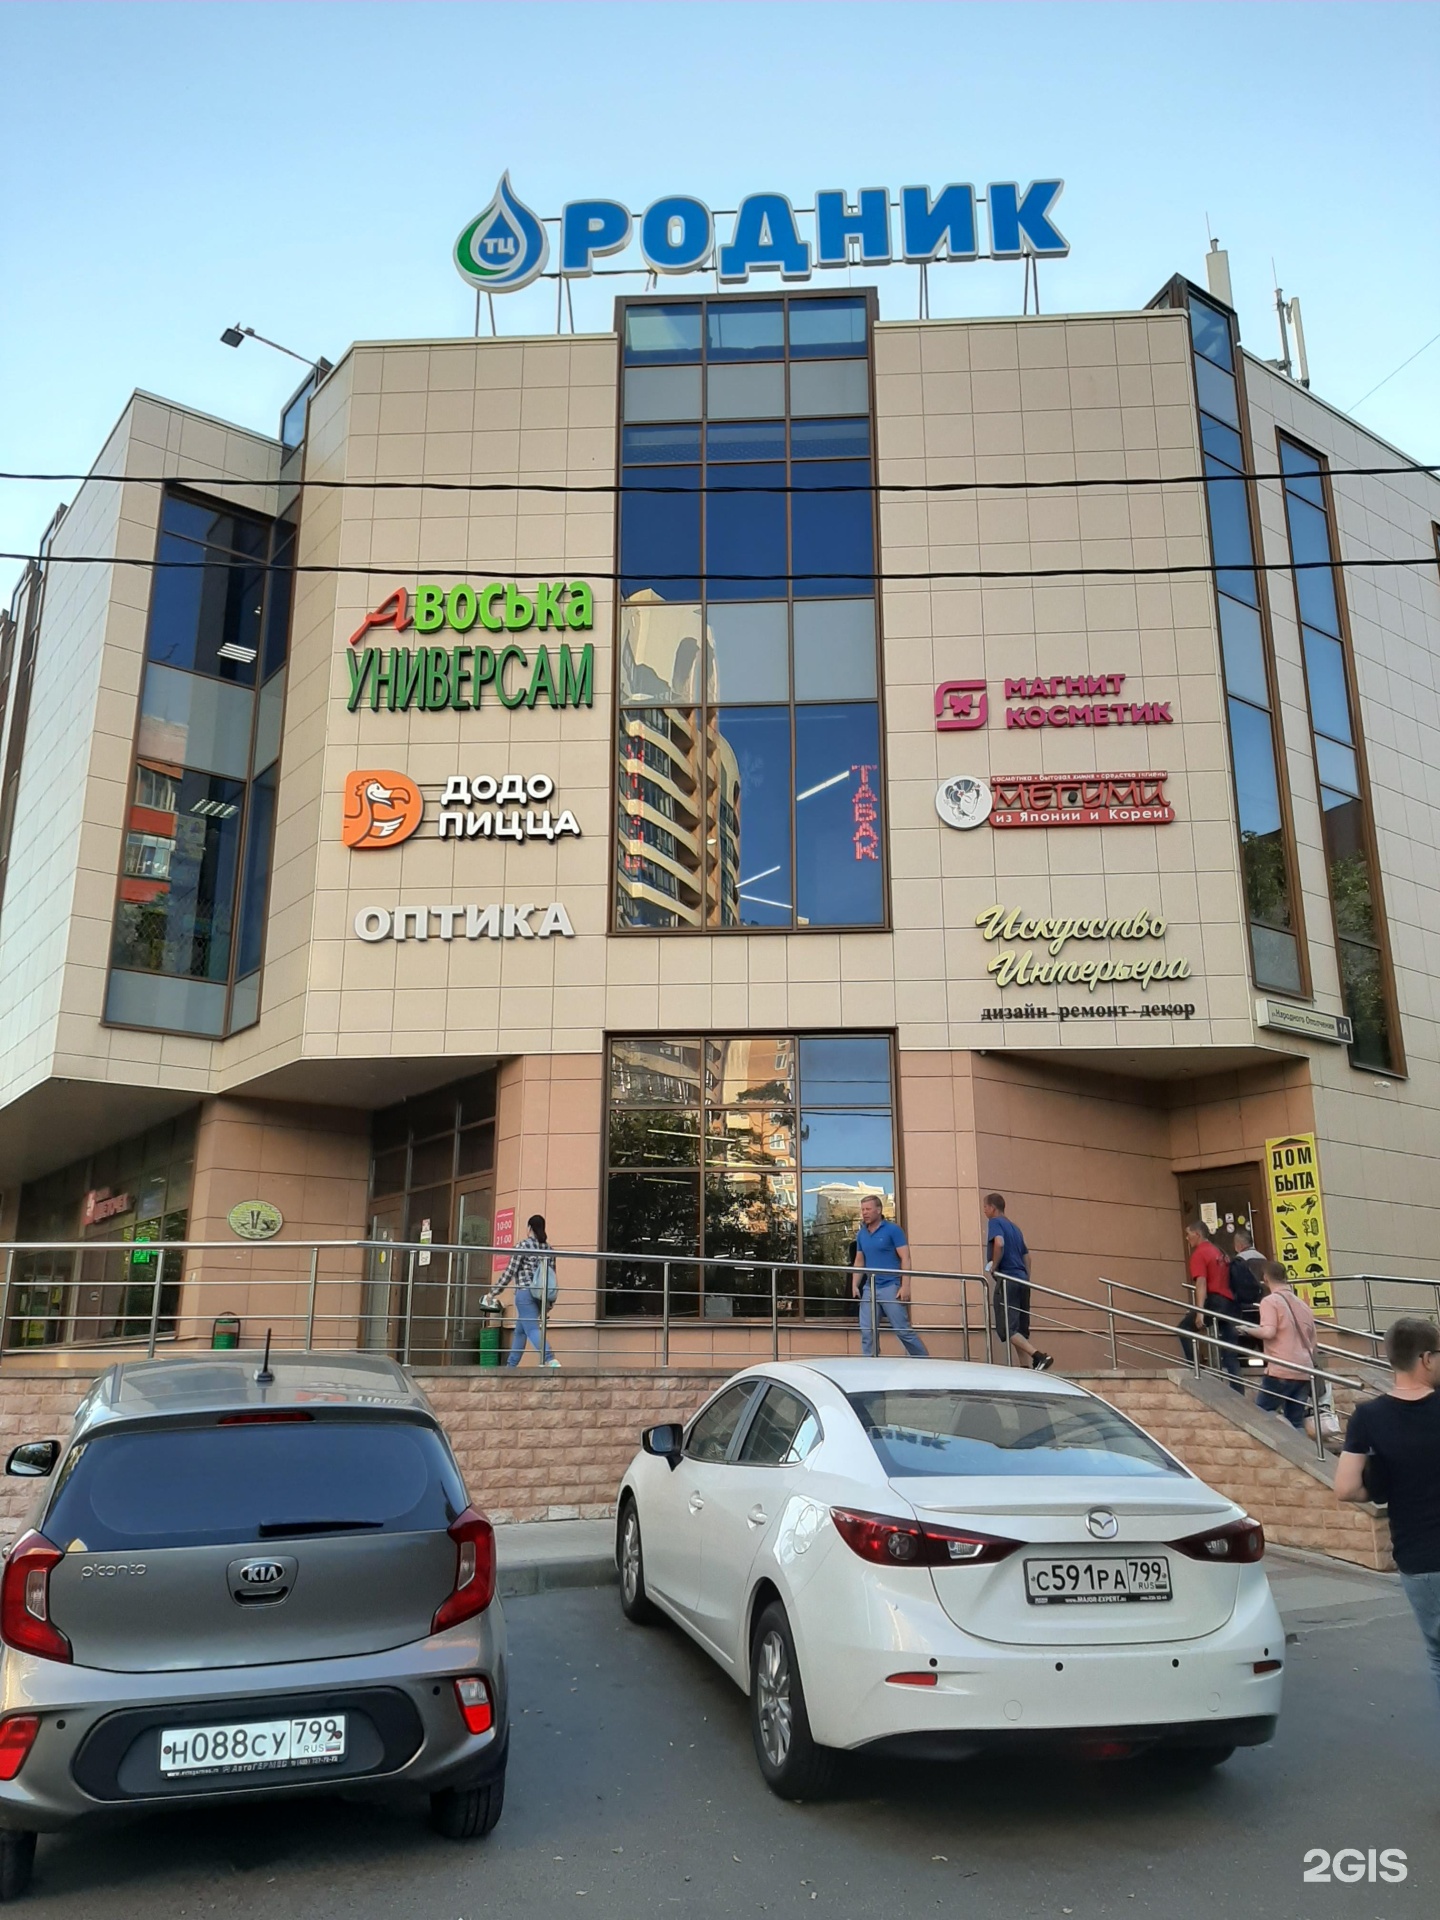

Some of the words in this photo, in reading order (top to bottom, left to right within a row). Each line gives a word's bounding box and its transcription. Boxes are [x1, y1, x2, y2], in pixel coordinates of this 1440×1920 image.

[561, 179, 1070, 283] РОДНИК
[483, 237, 515, 255] ТЦ
[346, 643, 594, 712] УНИВЕРСАМ
[1004, 673, 1126, 700] МАГНИТ
[1006, 701, 1173, 729] КОСМЕТИК
[440, 774, 554, 808] ДОДО
[992, 780, 1171, 810] МЕГУМИ
[438, 809, 581, 841] ПИЦЦА
[851, 764, 879, 860] ТАБАК
[995, 815, 1012, 823] из
[1020, 811, 1081, 823] Японии
[1090, 811, 1099, 820] и
[1109, 808, 1169, 821] Кореи!
[354, 902, 576, 942] ОПТИКА
[975, 903, 1168, 955] Искусство
[987, 949, 1191, 991] Интерьера
[981, 1003, 1048, 1020] дизайн
[1058, 1005, 1129, 1022] ремонт
[1140, 1003, 1195, 1020] декор
[1272, 1146, 1312, 1170] ДОМ
[1274, 1171, 1315, 1193] БЫТА
[247, 1566, 278, 1582] KIA
[1129, 1561, 1161, 1582] 799
[1138, 1581, 1155, 1590] RUS
[294, 1719, 338, 1745] 799
[303, 1743, 324, 1754] RUS
